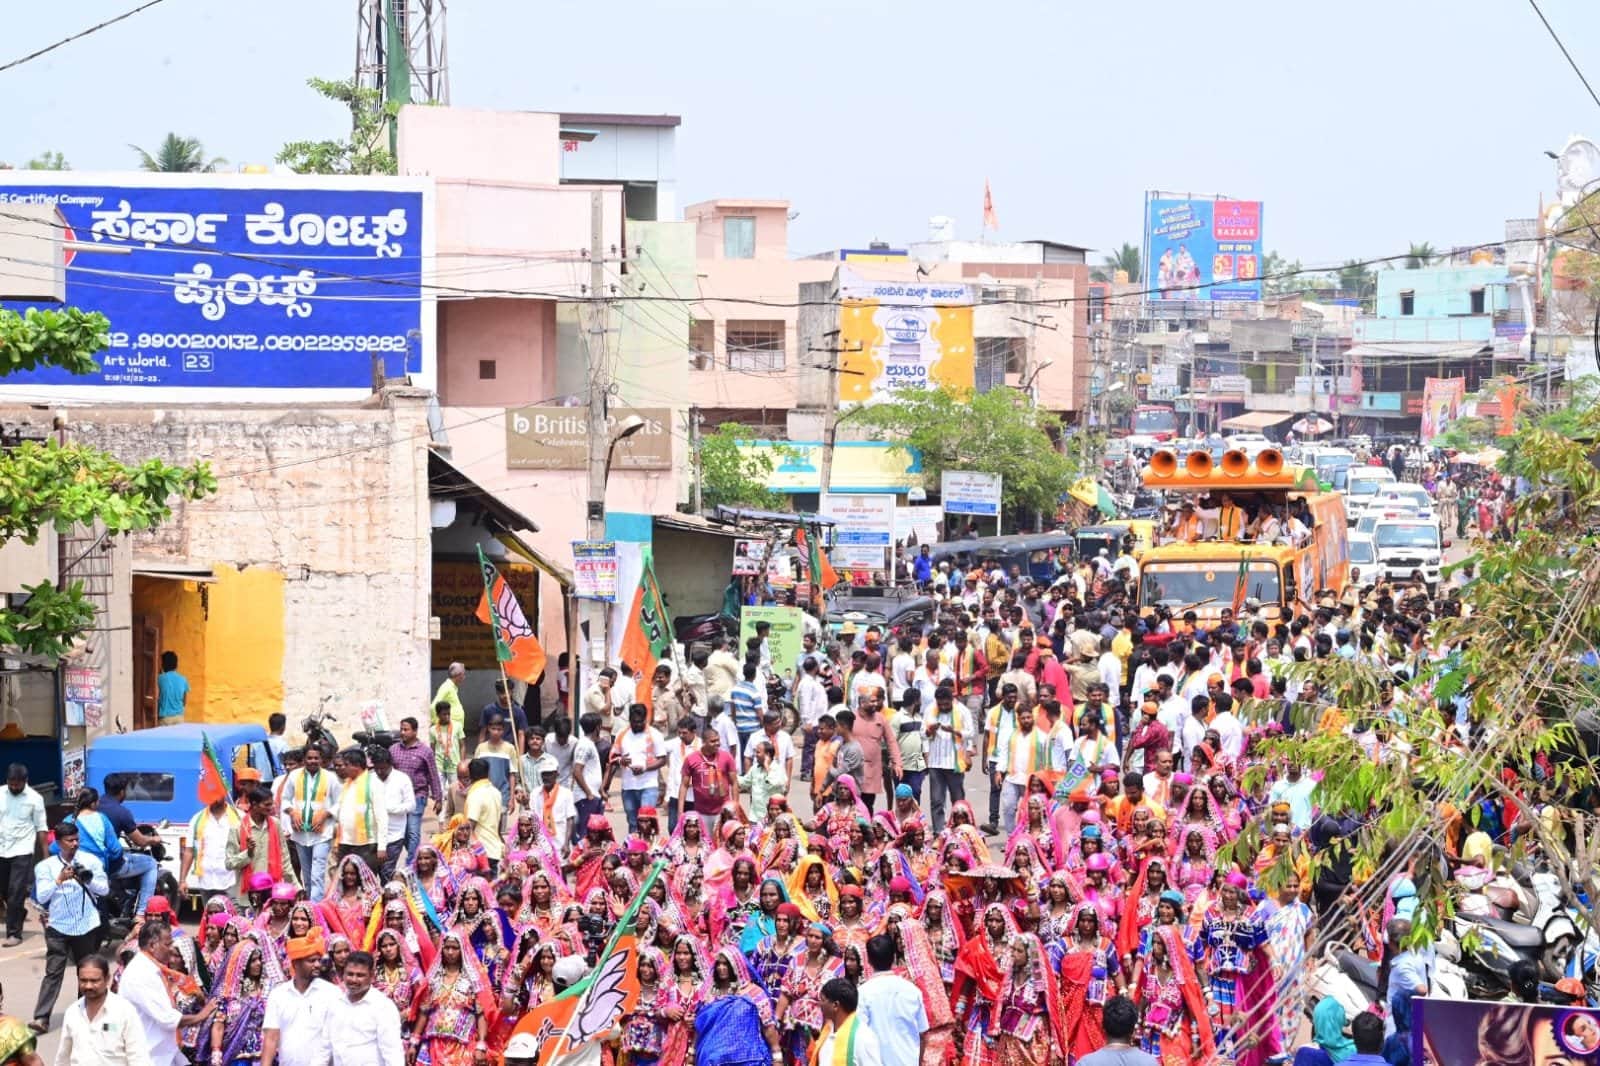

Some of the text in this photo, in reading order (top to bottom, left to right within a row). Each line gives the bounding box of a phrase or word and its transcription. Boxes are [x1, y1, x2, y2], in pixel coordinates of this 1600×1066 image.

[10, 194, 58, 204] Certified
[60, 194, 104, 208] Company
[245, 202, 408, 258] ಕೋಟ್ಸ್
[104, 355, 125, 366] Art
[186, 355, 210, 368] 23
[886, 364, 926, 378] ಶುಭಂ
